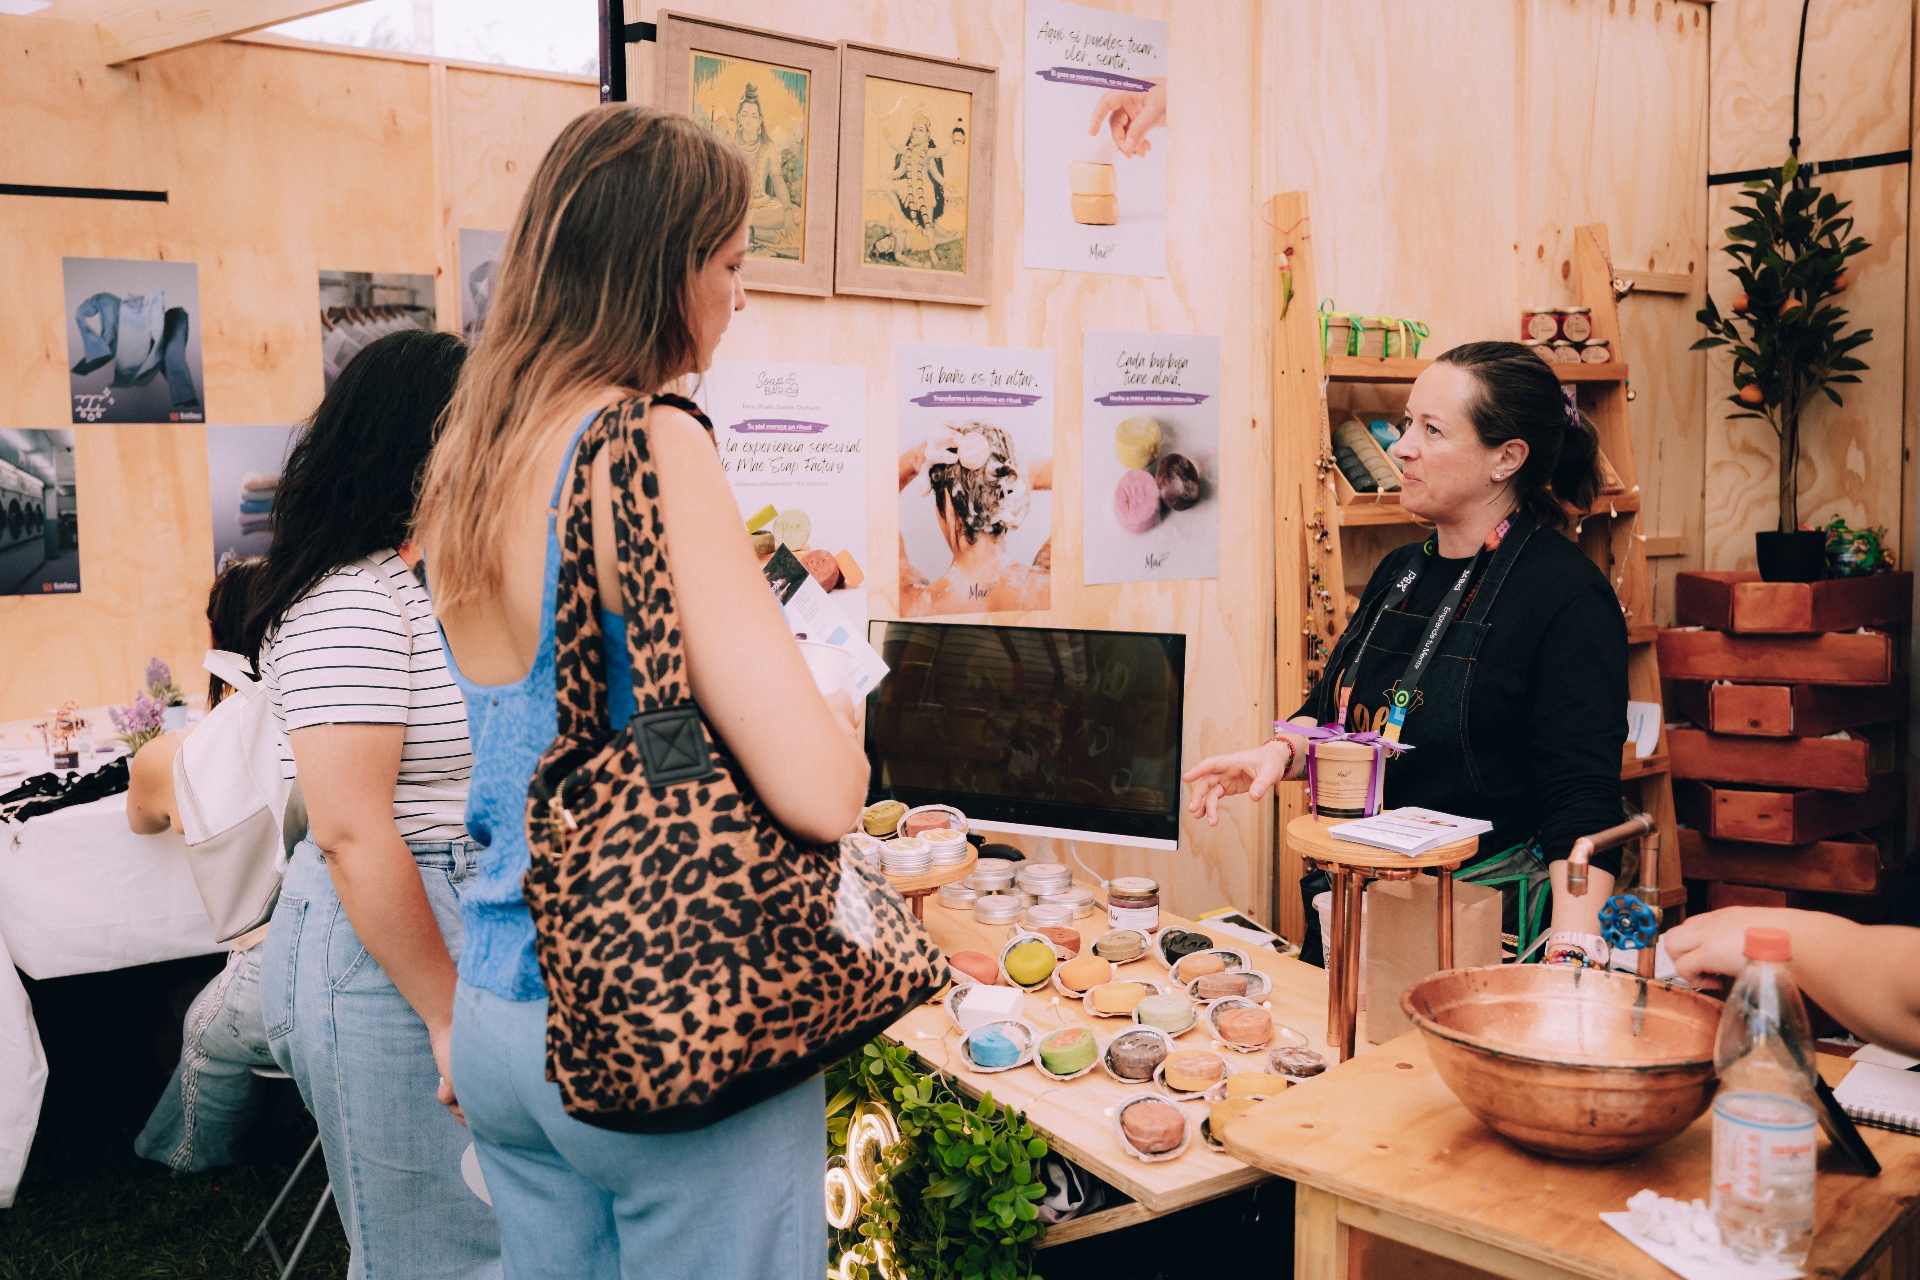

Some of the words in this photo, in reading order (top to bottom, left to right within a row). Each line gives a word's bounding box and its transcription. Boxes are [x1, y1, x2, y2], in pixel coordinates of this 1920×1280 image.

[1084, 33, 1124, 51] puedes
[1128, 36, 1157, 59] tocar,
[1096, 52, 1130, 70] sentir.
[1117, 350, 1145, 368] Cada
[1149, 352, 1189, 374] burbuja
[756, 371, 785, 390] Soap
[917, 364, 933, 384] Tu
[938, 366, 966, 384] baño
[971, 372, 986, 385] es
[990, 369, 1001, 387] tu
[1005, 369, 1038, 387] altar.
[1124, 368, 1147, 386] tiene
[1151, 370, 1181, 386] alma.
[764, 387, 784, 396] BAR
[933, 394, 965, 402] Transforma
[754, 423, 765, 431] piel
[726, 437, 738, 452] la
[742, 440, 804, 456] experiencia
[809, 438, 861, 454] sensorial
[736, 457, 765, 472] Mae
[769, 456, 799, 475] Soap
[805, 457, 844, 474] Factory
[1145, 553, 1162, 569] Mae
[1403, 569, 1417, 585] Bci
[1454, 578, 1466, 591] Bci
[968, 583, 988, 600] Mae
[1430, 606, 1451, 640] Emprende
[1425, 639, 1434, 648] tu
